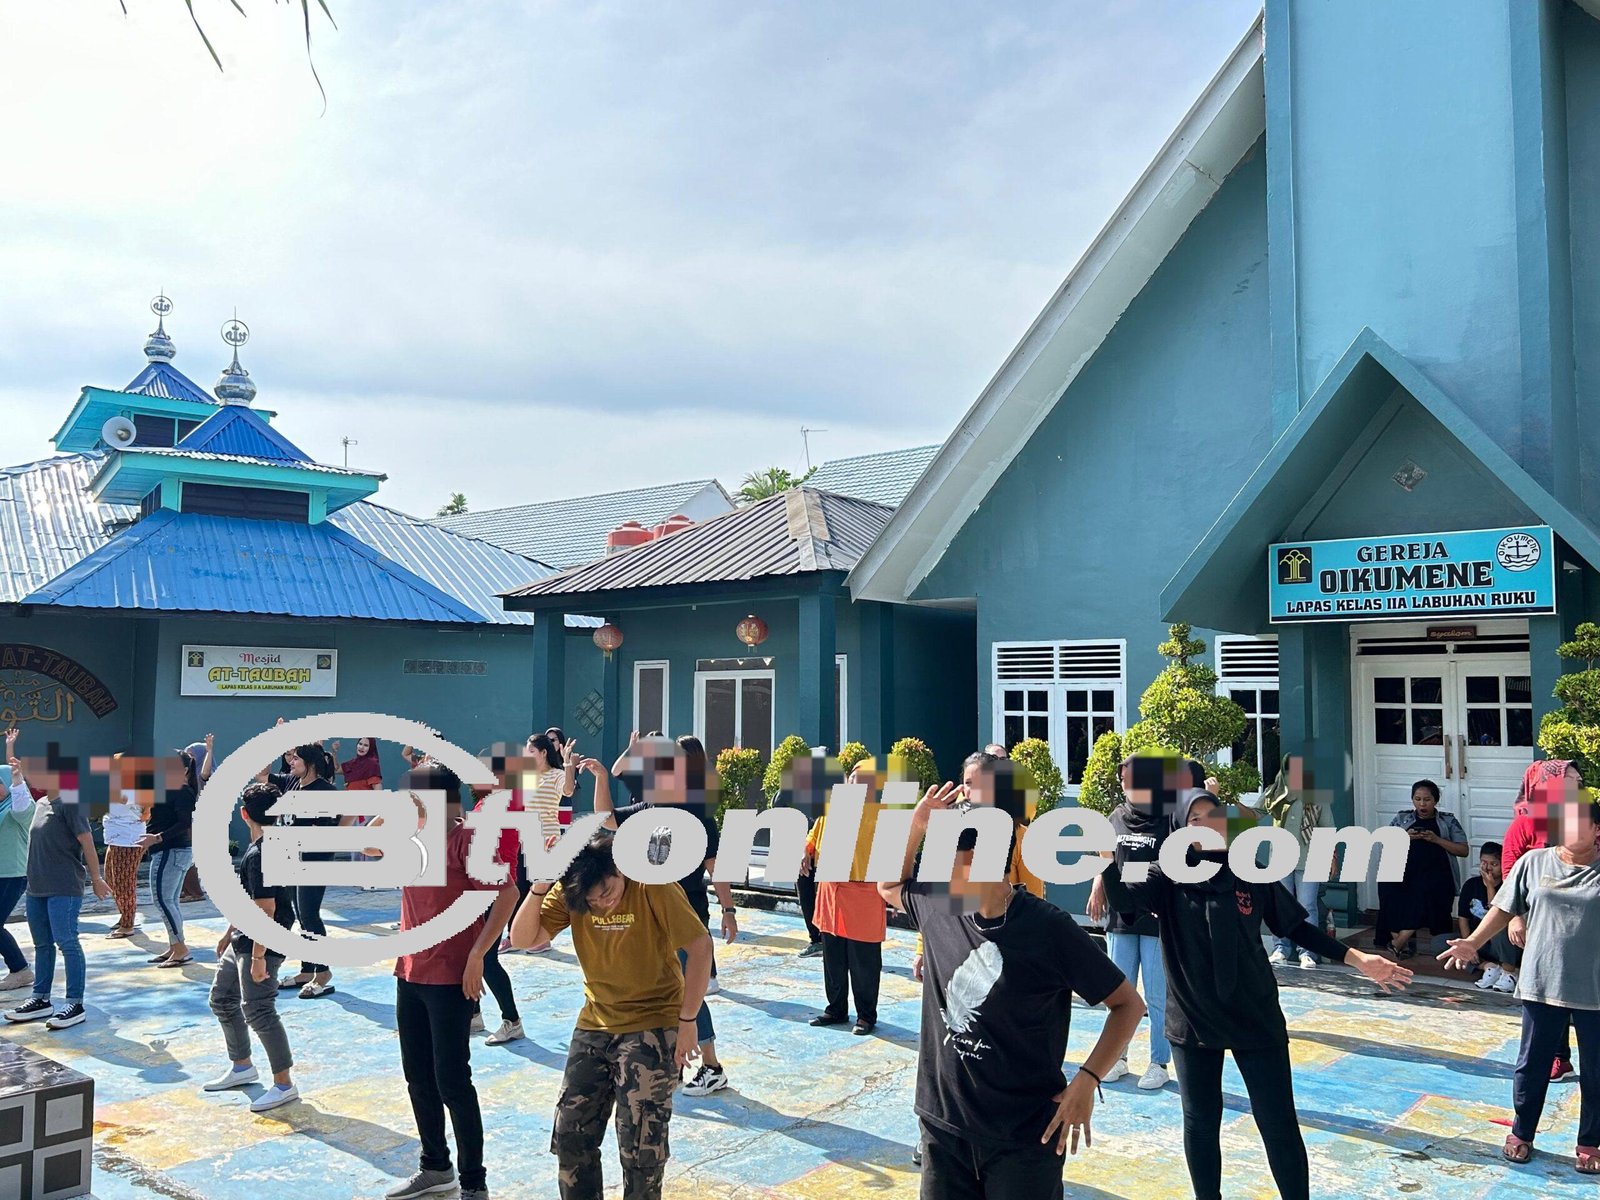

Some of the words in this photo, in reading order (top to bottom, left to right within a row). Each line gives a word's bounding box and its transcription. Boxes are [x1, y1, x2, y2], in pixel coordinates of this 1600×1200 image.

[1357, 542, 1448, 562] GEREJA
[1498, 535, 1539, 556] OIKOUMENE
[1320, 561, 1493, 594] OIKUMENE
[1287, 600, 1331, 613] LAPAS
[1336, 598, 1382, 611] KELAS
[1387, 597, 1407, 610] IIA
[1412, 594, 1485, 609] LABUHAN
[1491, 591, 1536, 606] RUKU
[239, 652, 281, 665] Mesjid
[2, 647, 115, 716] AT-TAUBAH
[208, 666, 311, 684] AT-TAUBAH
